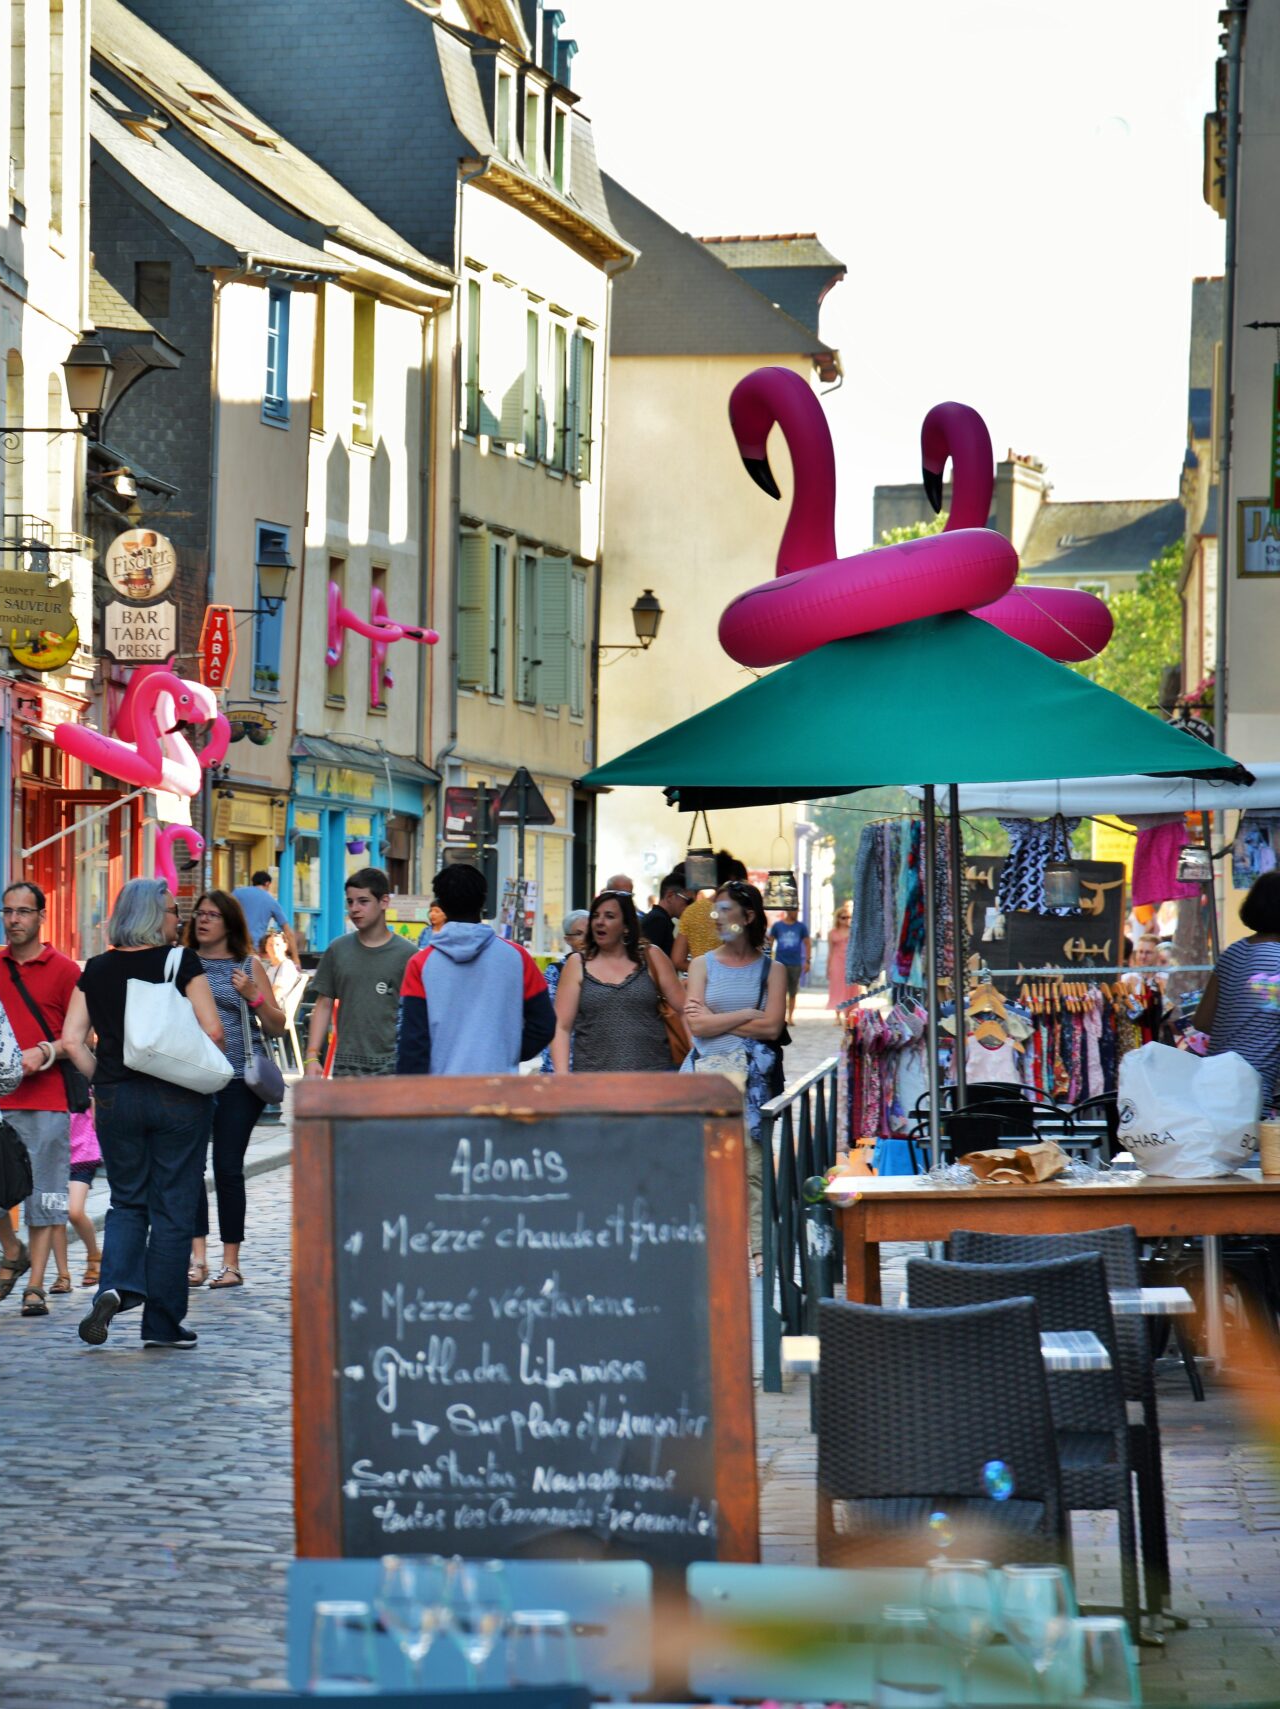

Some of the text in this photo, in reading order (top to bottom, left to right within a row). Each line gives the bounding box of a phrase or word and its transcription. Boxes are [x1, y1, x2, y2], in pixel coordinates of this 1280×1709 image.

[112, 547, 169, 576] Fischer
[3, 598, 63, 614] SAUVEUR
[121, 610, 159, 624] BAR
[111, 627, 171, 641] TABAC
[117, 644, 163, 658] PRESSE
[209, 616, 225, 681] TABAC
[449, 1137, 569, 1195] Adonis
[371, 1334, 512, 1414] Grillades
